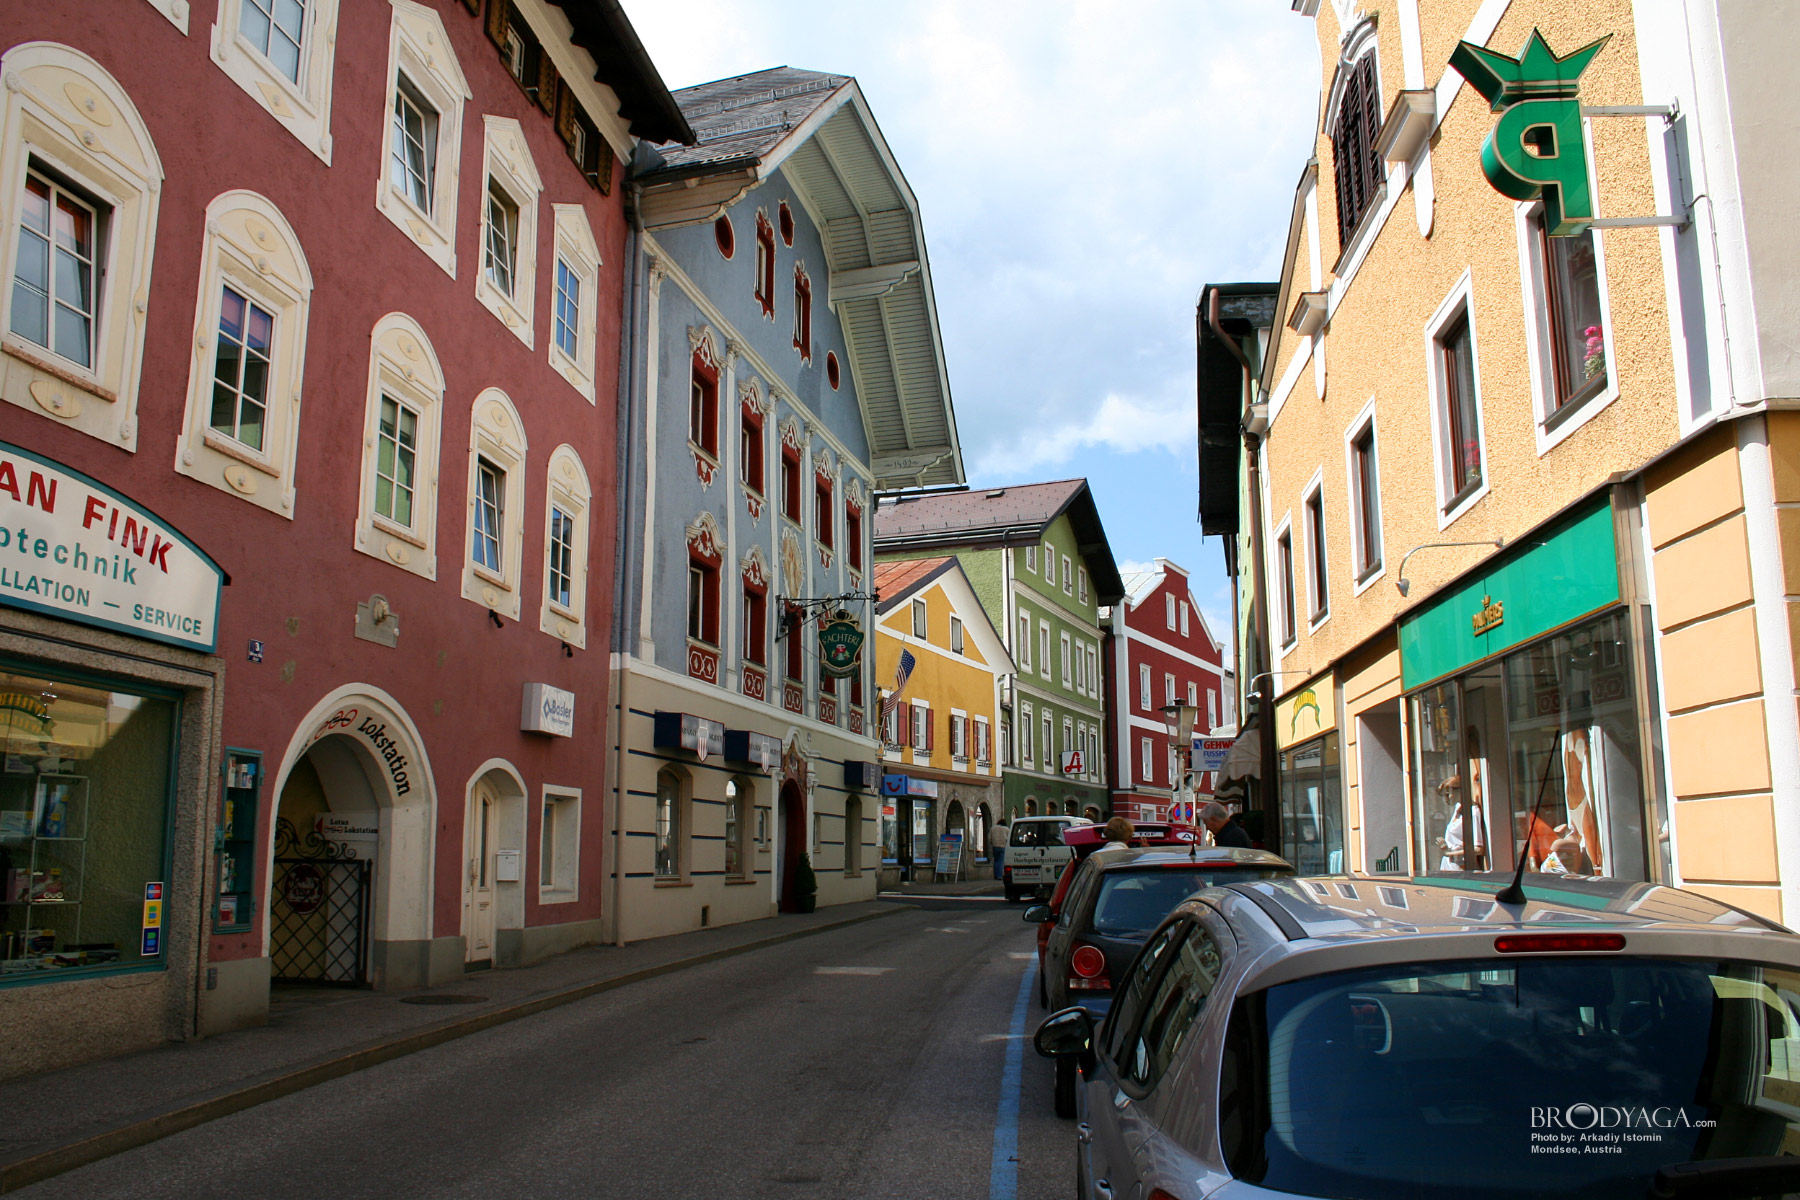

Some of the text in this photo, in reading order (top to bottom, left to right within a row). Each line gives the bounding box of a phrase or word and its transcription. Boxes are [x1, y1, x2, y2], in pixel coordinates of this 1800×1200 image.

[83, 494, 173, 574] FINK
[1, 567, 90, 607] LLATION
[133, 603, 202, 635] SERVICE
[255, 642, 260, 651] 3
[357, 716, 411, 797] Lokstation
[1203, 750, 1229, 758] FUSSPF
